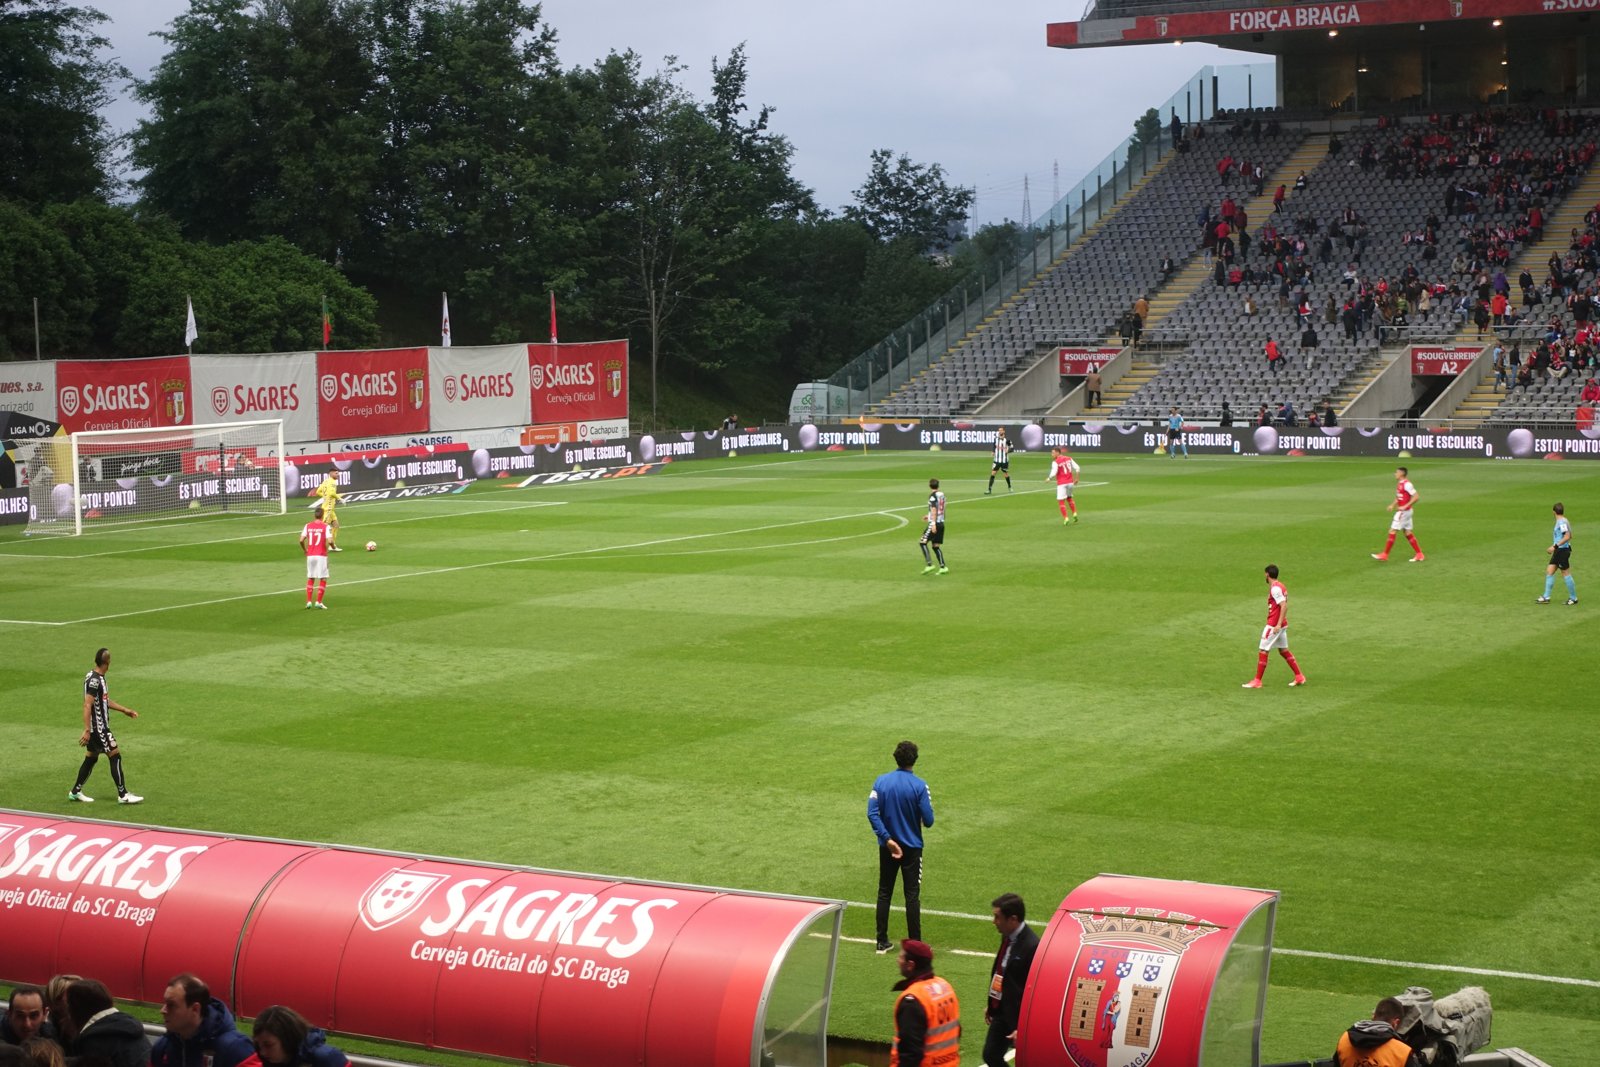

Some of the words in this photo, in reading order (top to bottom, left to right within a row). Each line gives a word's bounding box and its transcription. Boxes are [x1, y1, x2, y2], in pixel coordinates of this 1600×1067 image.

[1230, 9, 1292, 31] FORÇA
[1295, 4, 1360, 26] BRAGA
[545, 362, 595, 388] SAGRES
[1440, 361, 1458, 374] A2
[340, 370, 397, 401] SAGRES
[460, 372, 514, 402] SAGRES
[82, 381, 150, 415] SAGRES
[233, 383, 300, 415] SAGRES
[546, 394, 573, 405] Cerveja
[573, 391, 596, 402] Oficial
[341, 405, 373, 418] Cerveja
[374, 403, 398, 415] Oficial
[10, 427, 28, 436] LIGA
[29, 421, 51, 437] NOS
[121, 418, 152, 429] Oficial
[589, 426, 619, 436] Cachapuz
[418, 435, 453, 445] SABSEG
[721, 435, 730, 450] ÉS
[730, 436, 738, 448] TU
[738, 434, 750, 447] QUE
[750, 432, 782, 446] ESCOLHES
[818, 432, 844, 444] ESTO!
[846, 432, 880, 445] PONTO!
[920, 429, 931, 444] ÉS
[932, 431, 943, 443] TU
[944, 429, 960, 443] QUE
[1044, 433, 1068, 446] ESTO!
[1069, 433, 1101, 447] PONTO!
[1143, 431, 1155, 446] ÉS
[1188, 433, 1232, 446] ESCOLHES
[1278, 435, 1304, 449] ESTO!
[1306, 436, 1341, 450] PONTO!
[1387, 434, 1399, 450] ÉS
[1401, 436, 1414, 449] TU
[1415, 434, 1434, 448] QUE
[1436, 435, 1484, 449] ESCOLHES
[1534, 438, 1563, 452] ESTO!
[565, 447, 574, 464] ÉS
[574, 449, 583, 462] TU
[583, 447, 596, 461] QUE
[596, 444, 626, 460] ESCOLHES
[655, 442, 673, 456] ESTO!
[673, 441, 695, 455] PONTO!
[386, 463, 396, 480] ÉS
[397, 464, 407, 479] TU
[407, 461, 422, 478] QUE
[422, 458, 457, 476] ESCOLHES
[490, 456, 510, 471] ESTO!
[510, 454, 535, 470] PONTO!
[179, 482, 190, 499] ÉS
[191, 482, 202, 498] TU
[203, 480, 220, 496] QUE
[225, 476, 261, 494] SCOLHES
[300, 473, 322, 490] ESTO!
[104, 490, 136, 508] PONTO!
[340, 490, 392, 504] LIGA
[396, 484, 453, 499] NOS
[308, 531, 322, 546] 17
[0, 827, 209, 900] SAGRES
[26, 888, 73, 910] Oficial
[72, 895, 90, 914] do
[91, 897, 115, 917] SC
[114, 900, 156, 927] Braga
[419, 878, 679, 959] SAGRES
[410, 939, 469, 970] Cerveja
[471, 948, 524, 973] Oficial
[527, 954, 548, 975] do
[551, 956, 577, 978] SC
[579, 959, 630, 989] Braga
[1092, 947, 1165, 964] SPORTING
